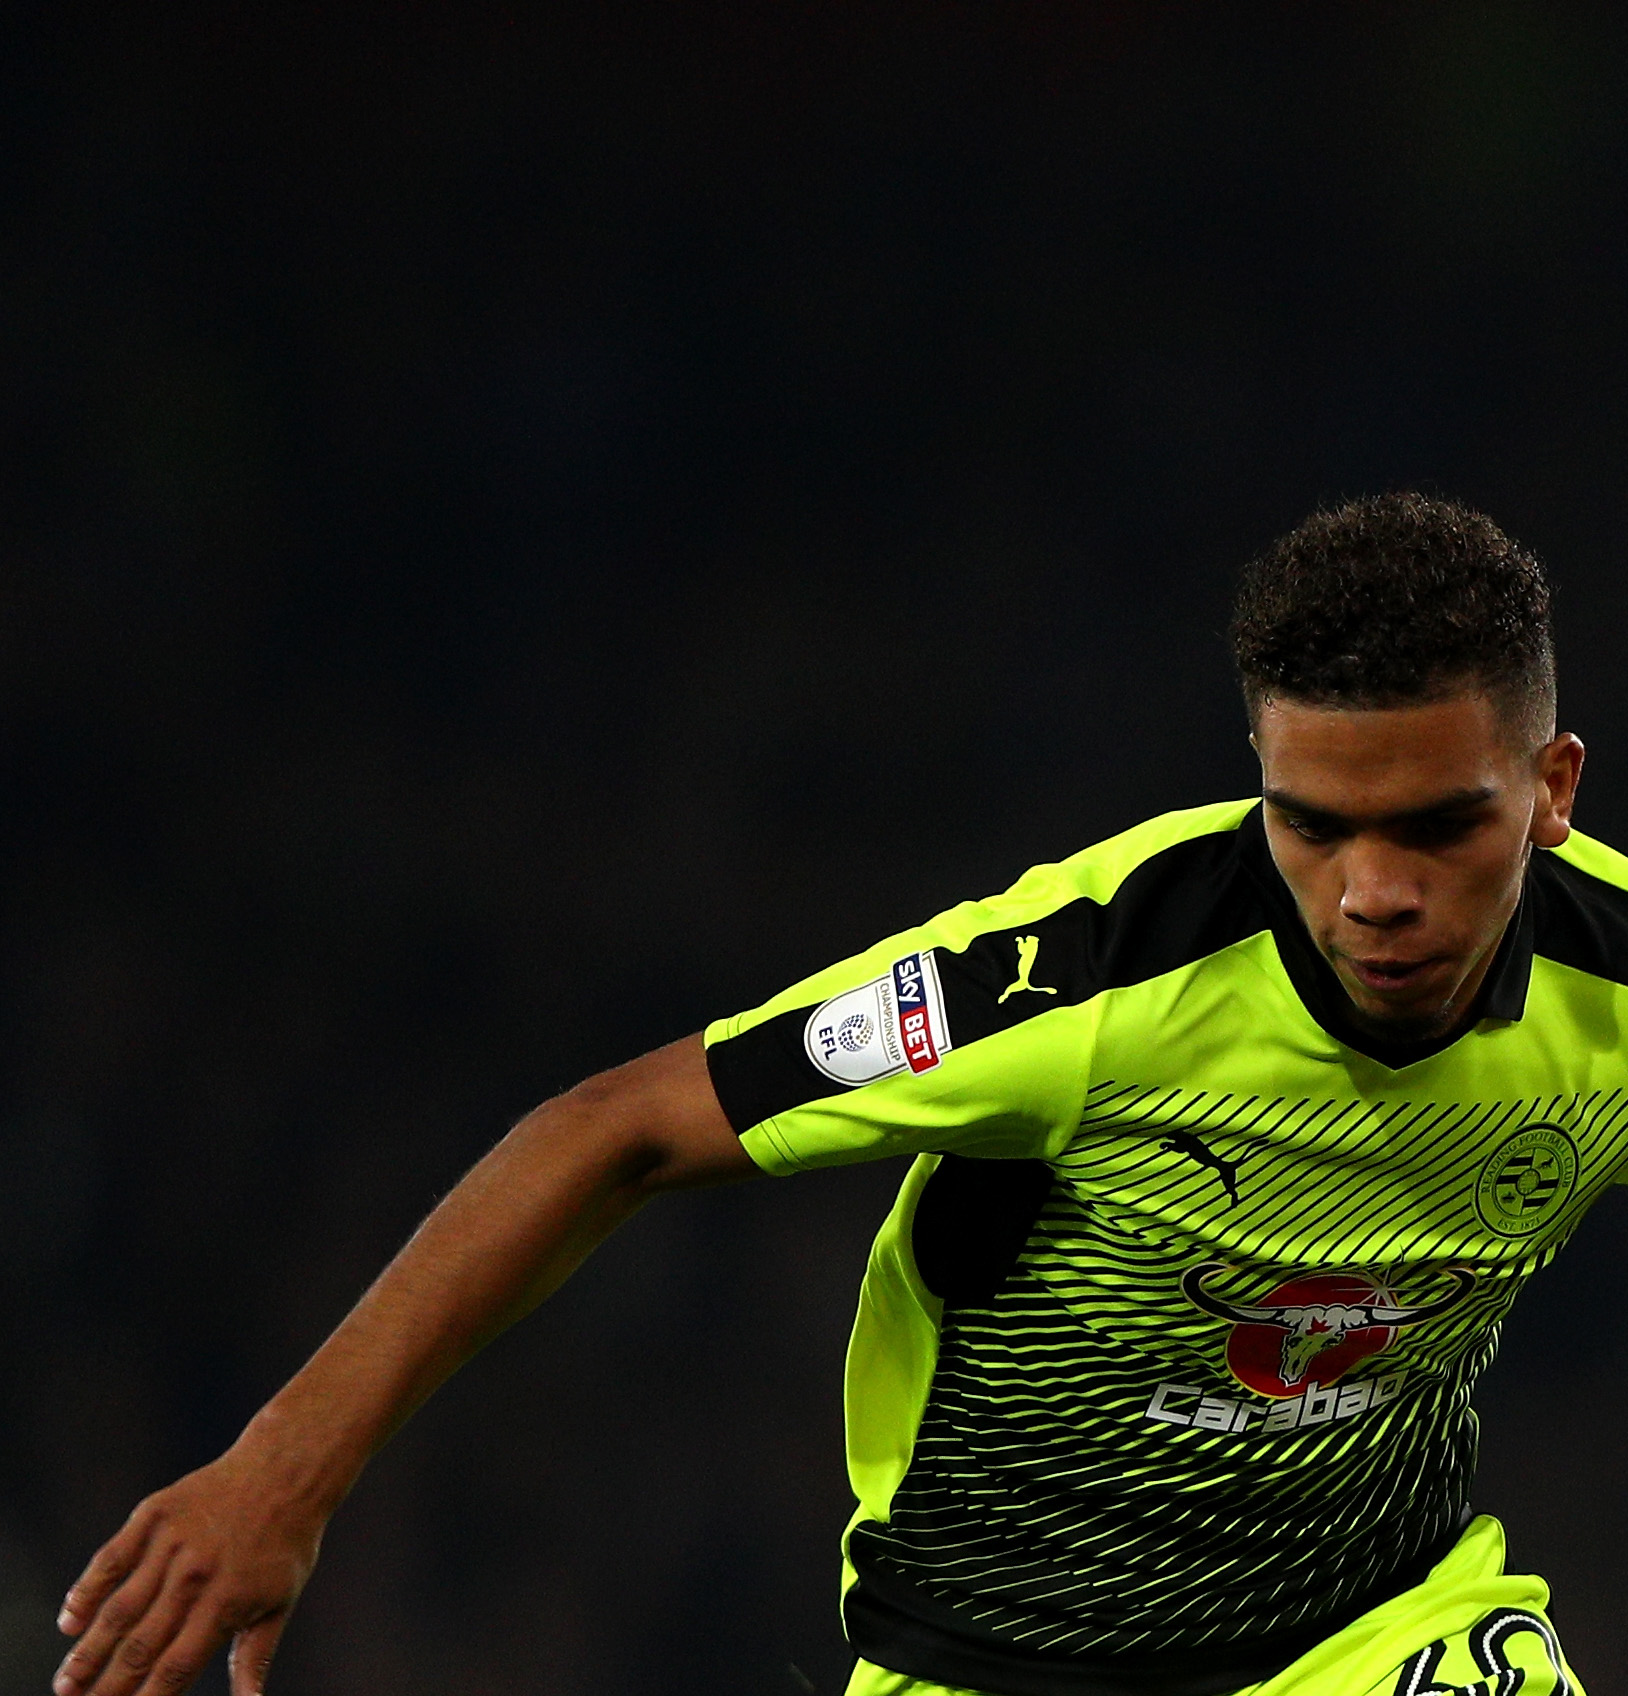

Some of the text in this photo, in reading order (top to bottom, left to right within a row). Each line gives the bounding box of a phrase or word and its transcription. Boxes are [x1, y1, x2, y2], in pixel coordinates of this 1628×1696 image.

[818, 1026, 838, 1061] EFL
[879, 983, 901, 1061] CHAMPIONSHIP
[898, 960, 932, 1061] sky BET
[1145, 1371, 1409, 1433] Carabao
